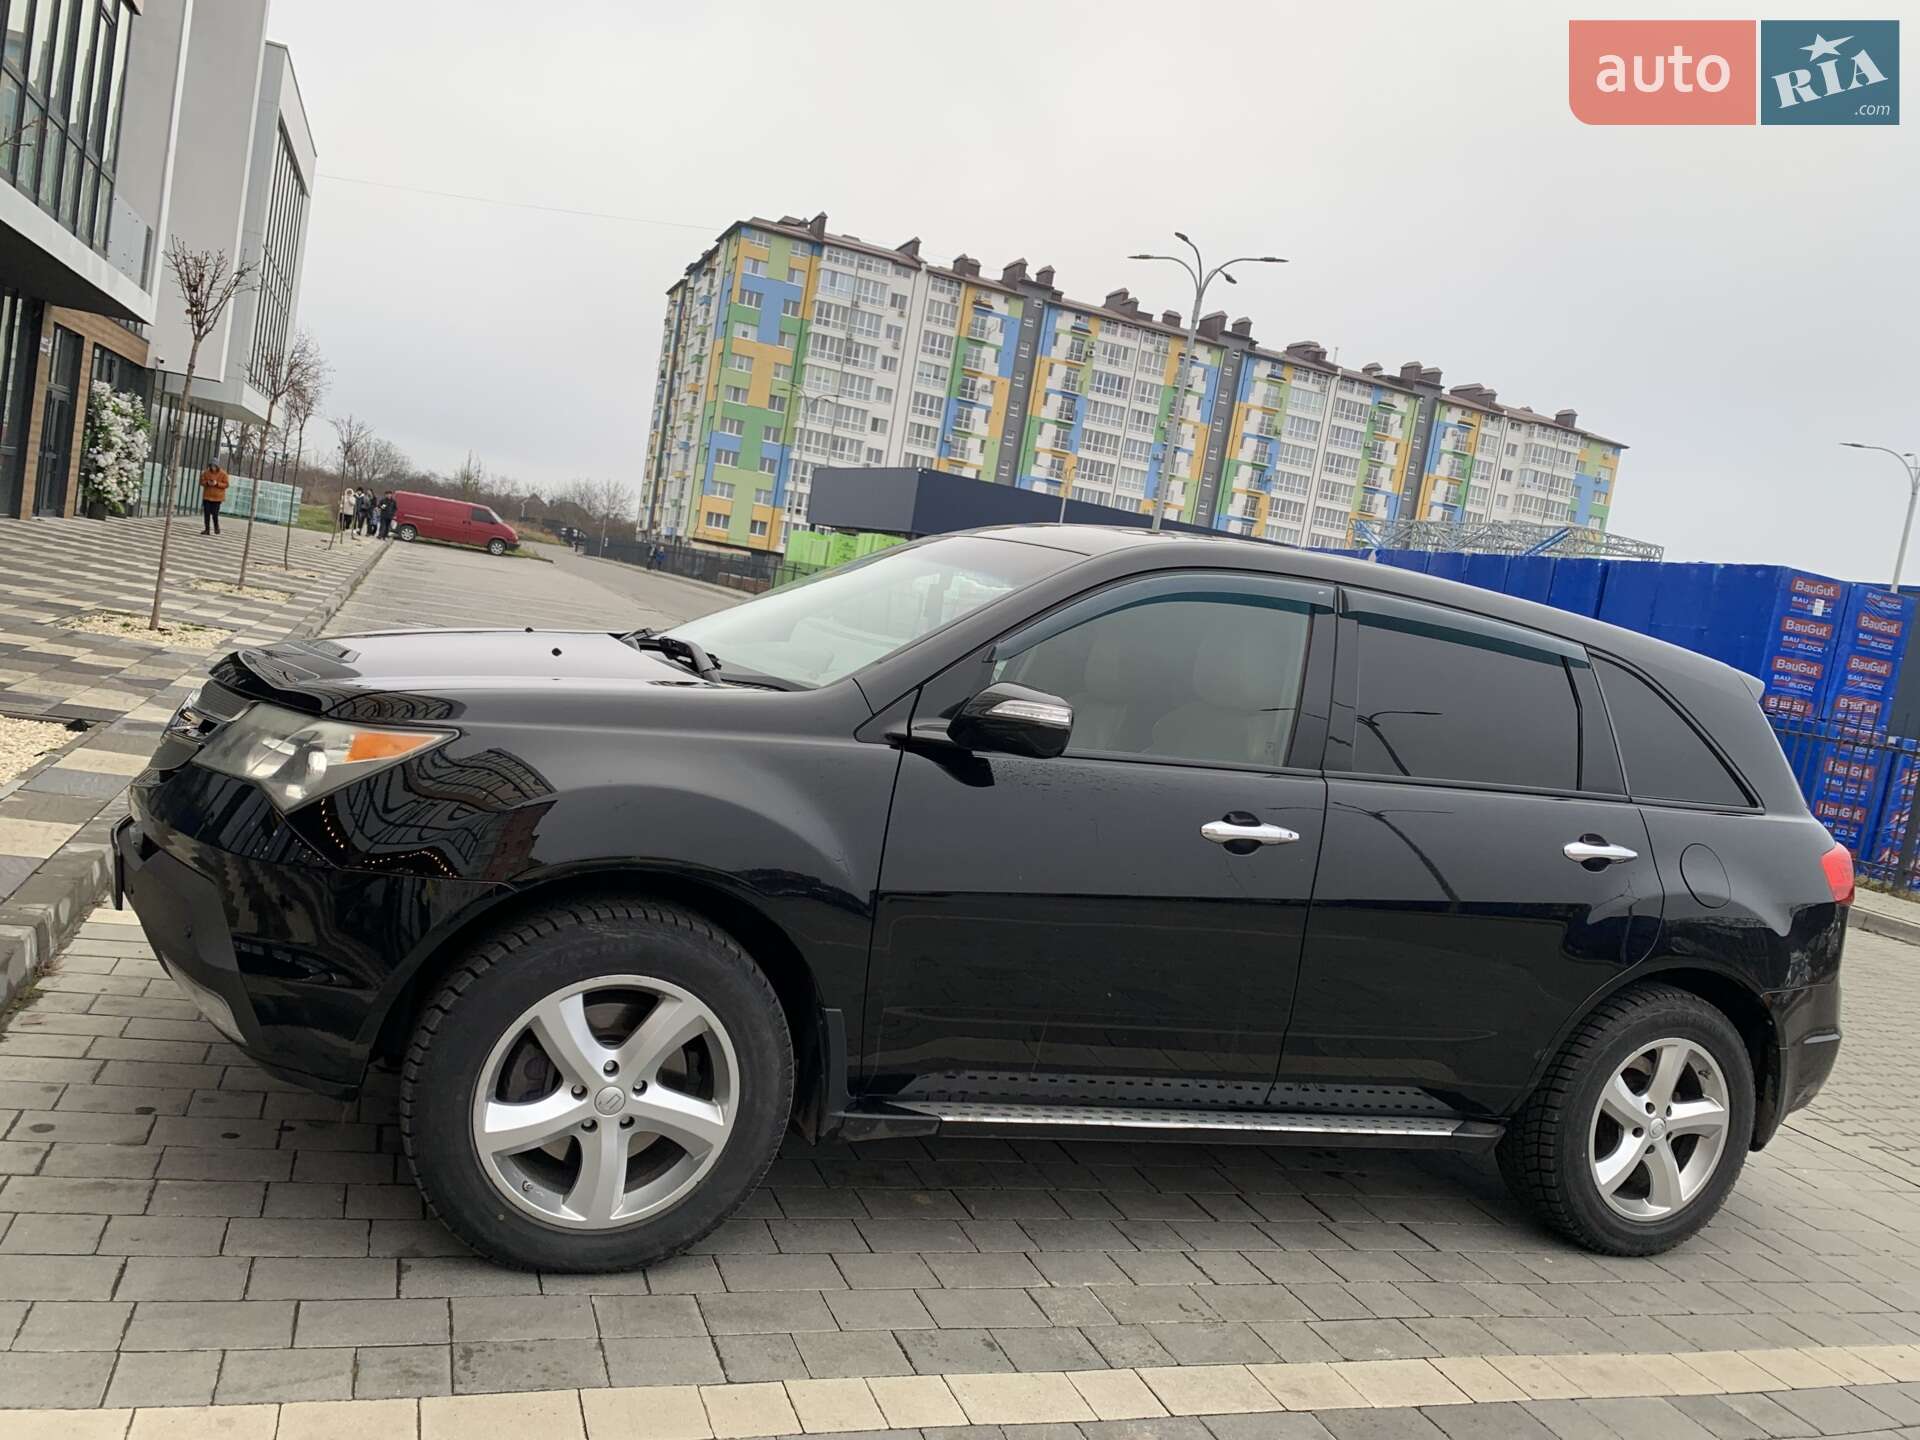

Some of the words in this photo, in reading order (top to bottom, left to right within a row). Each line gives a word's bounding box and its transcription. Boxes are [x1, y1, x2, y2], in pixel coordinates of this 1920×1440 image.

[1795, 580, 1835, 597] BauGut
[1785, 619, 1827, 637] BauGut
[1861, 615, 1898, 634] BauGut
[1782, 635, 1800, 643] BAU
[1870, 640, 1894, 651] BLOCK
[1797, 642, 1824, 654] BLOCK
[1775, 658, 1818, 676] BauGut
[1850, 657, 1888, 674] BauGut
[1773, 674, 1791, 682] BAU
